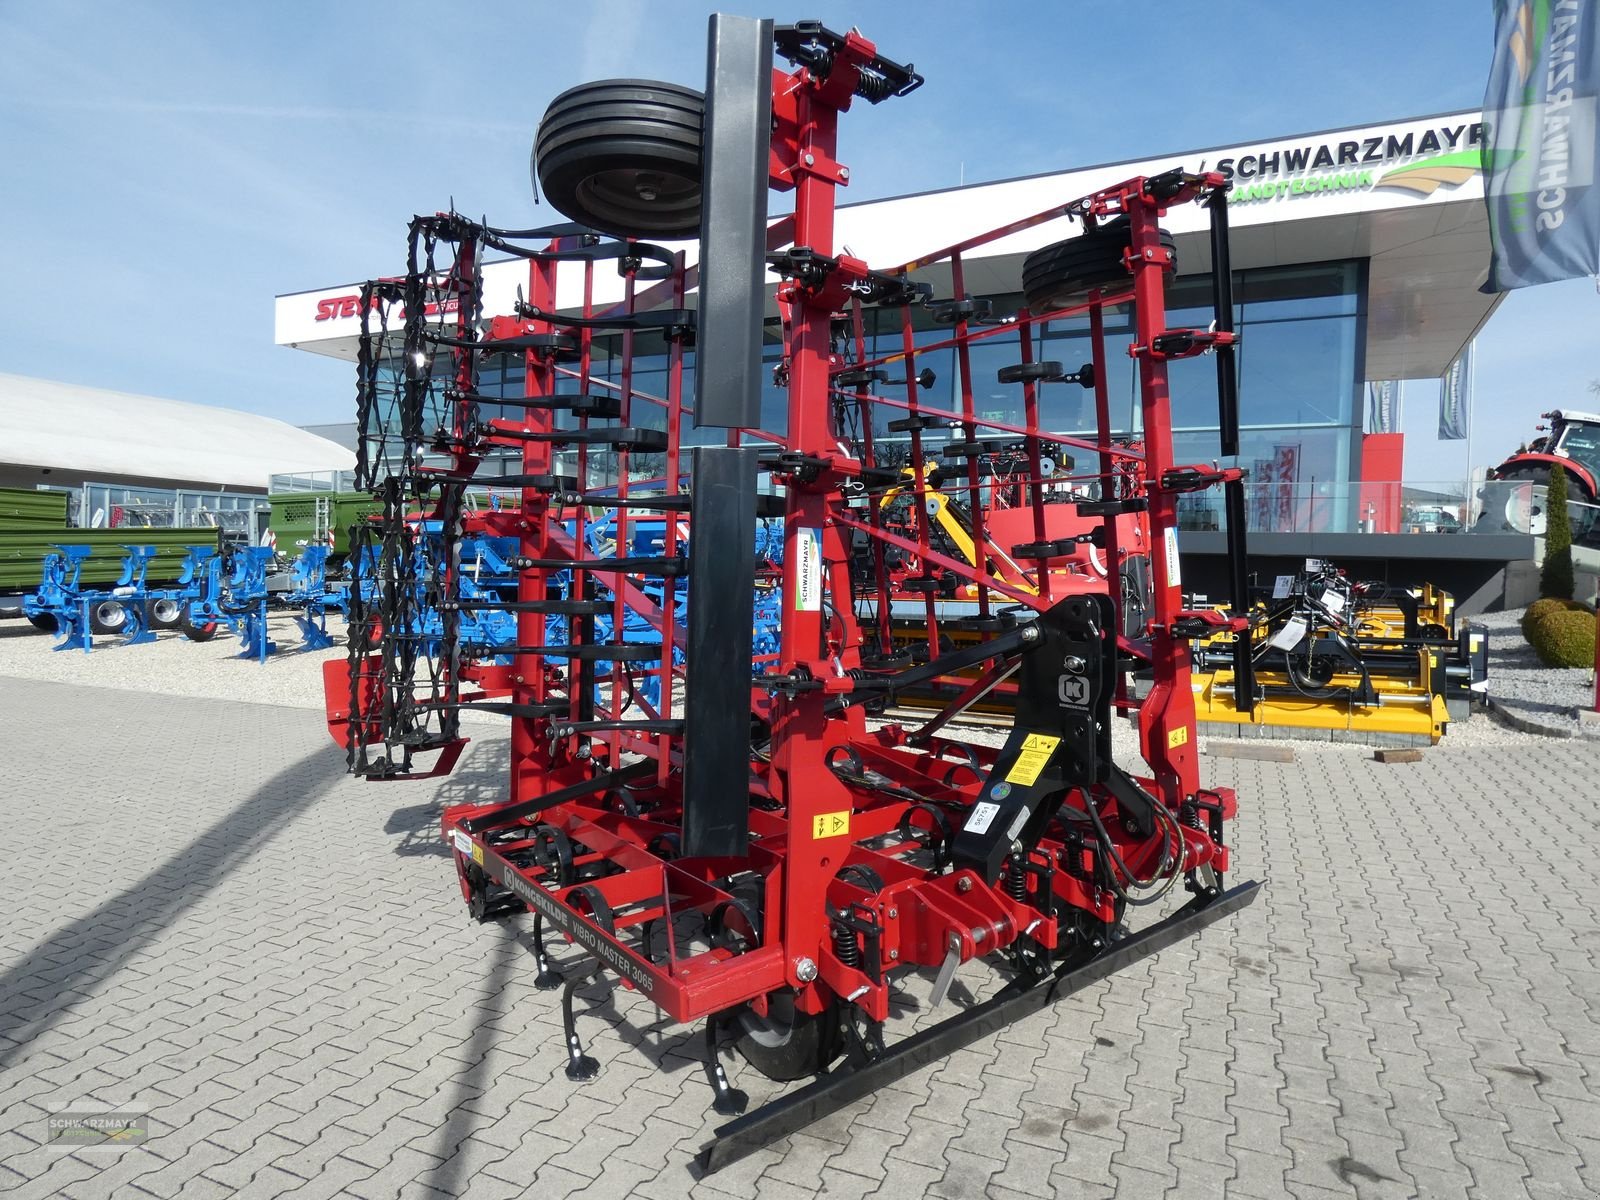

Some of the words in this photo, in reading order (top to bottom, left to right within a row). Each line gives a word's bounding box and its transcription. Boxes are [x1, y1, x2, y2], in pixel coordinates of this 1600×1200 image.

[1215, 122, 1492, 180] SCHWARZMAYR
[1229, 169, 1373, 203] ANDTECHNIK
[974, 806, 990, 827] 56751
[514, 877, 568, 927] KONGSKILDE
[572, 919, 596, 947] VIBRO
[597, 941, 631, 976] MASTER
[632, 966, 654, 992] 3065
